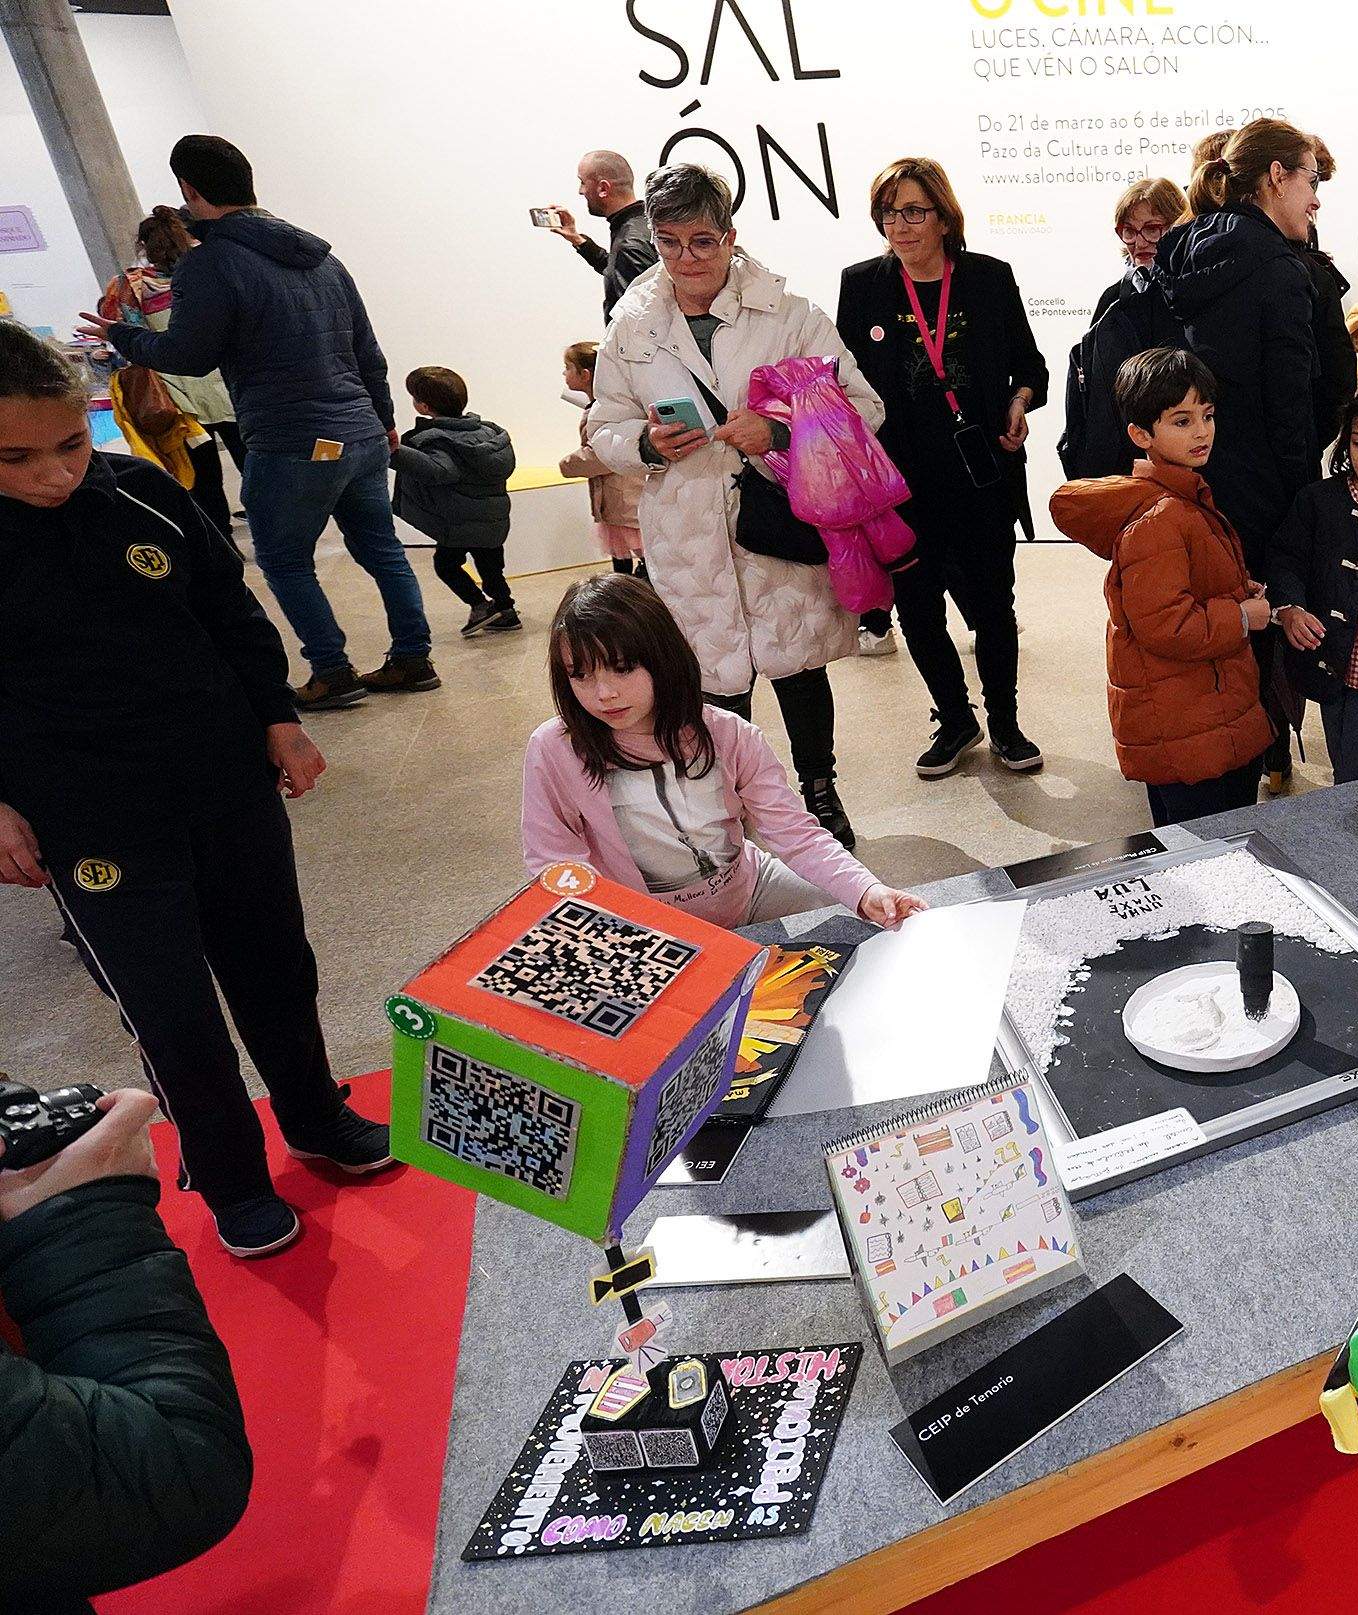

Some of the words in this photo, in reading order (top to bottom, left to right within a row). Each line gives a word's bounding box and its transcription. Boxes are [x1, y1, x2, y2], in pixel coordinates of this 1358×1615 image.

[973, 57, 1021, 82] QUE
[1026, 51, 1072, 76] VÉN
[1080, 56, 1097, 76] O
[1104, 50, 1179, 76] SALÓN
[978, 115, 1002, 132] Do
[1008, 114, 1024, 132] 21
[1030, 113, 1049, 131] de
[1055, 116, 1104, 130] marzo
[1110, 117, 1128, 129] ao
[1134, 111, 1144, 129] 6
[1150, 111, 1169, 128] de
[1175, 109, 1209, 128] abril
[1215, 108, 1234, 127] de
[981, 141, 1017, 158] Pazo
[1024, 140, 1041, 157] da
[1047, 139, 1108, 157] Cultura
[1114, 138, 1133, 155] de
[988, 213, 1047, 225] FRANCIA
[1028, 297, 1066, 306] Concello
[1042, 308, 1092, 316] Pontevedra
[918, 1413, 952, 1441] CEIP
[955, 1406, 971, 1418] de
[968, 1375, 1014, 1405] Tenorio
[540, 1513, 628, 1546] COMO
[638, 1508, 735, 1537] NACEN
[746, 1505, 781, 1527] AS
